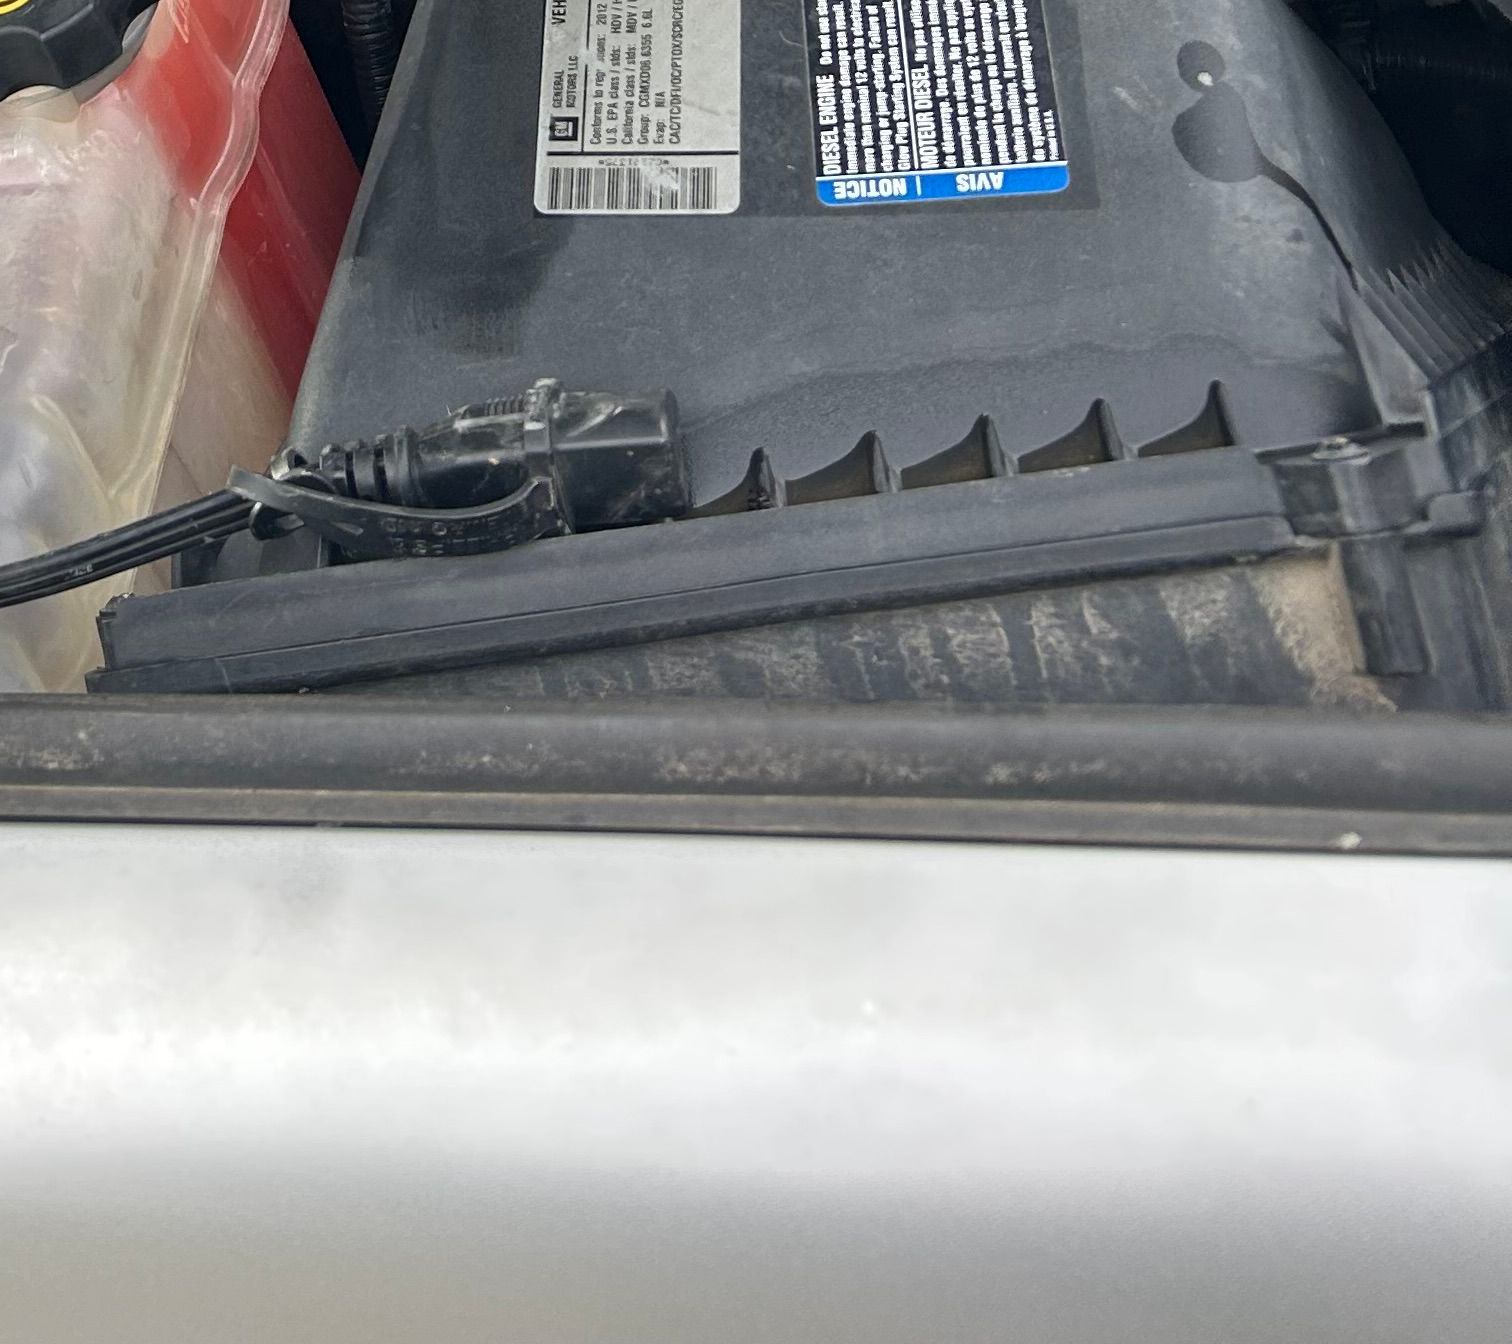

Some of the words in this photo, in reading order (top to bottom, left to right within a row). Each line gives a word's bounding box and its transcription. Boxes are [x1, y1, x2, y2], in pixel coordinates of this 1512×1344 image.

[595, 3, 607, 24] 2012
[610, 13, 622, 33] HDV
[625, 11, 637, 33] MDV
[551, 69, 564, 108] GENERAL
[566, 72, 577, 108] MOTORS
[815, 74, 837, 125] ENGINE
[909, 63, 933, 111] DIESEL
[607, 102, 618, 120] EPA
[819, 125, 841, 176] DIESEL
[915, 111, 939, 169] MOTEUR
[832, 176, 908, 200] NOTICE
[954, 170, 1006, 193] AVIS
